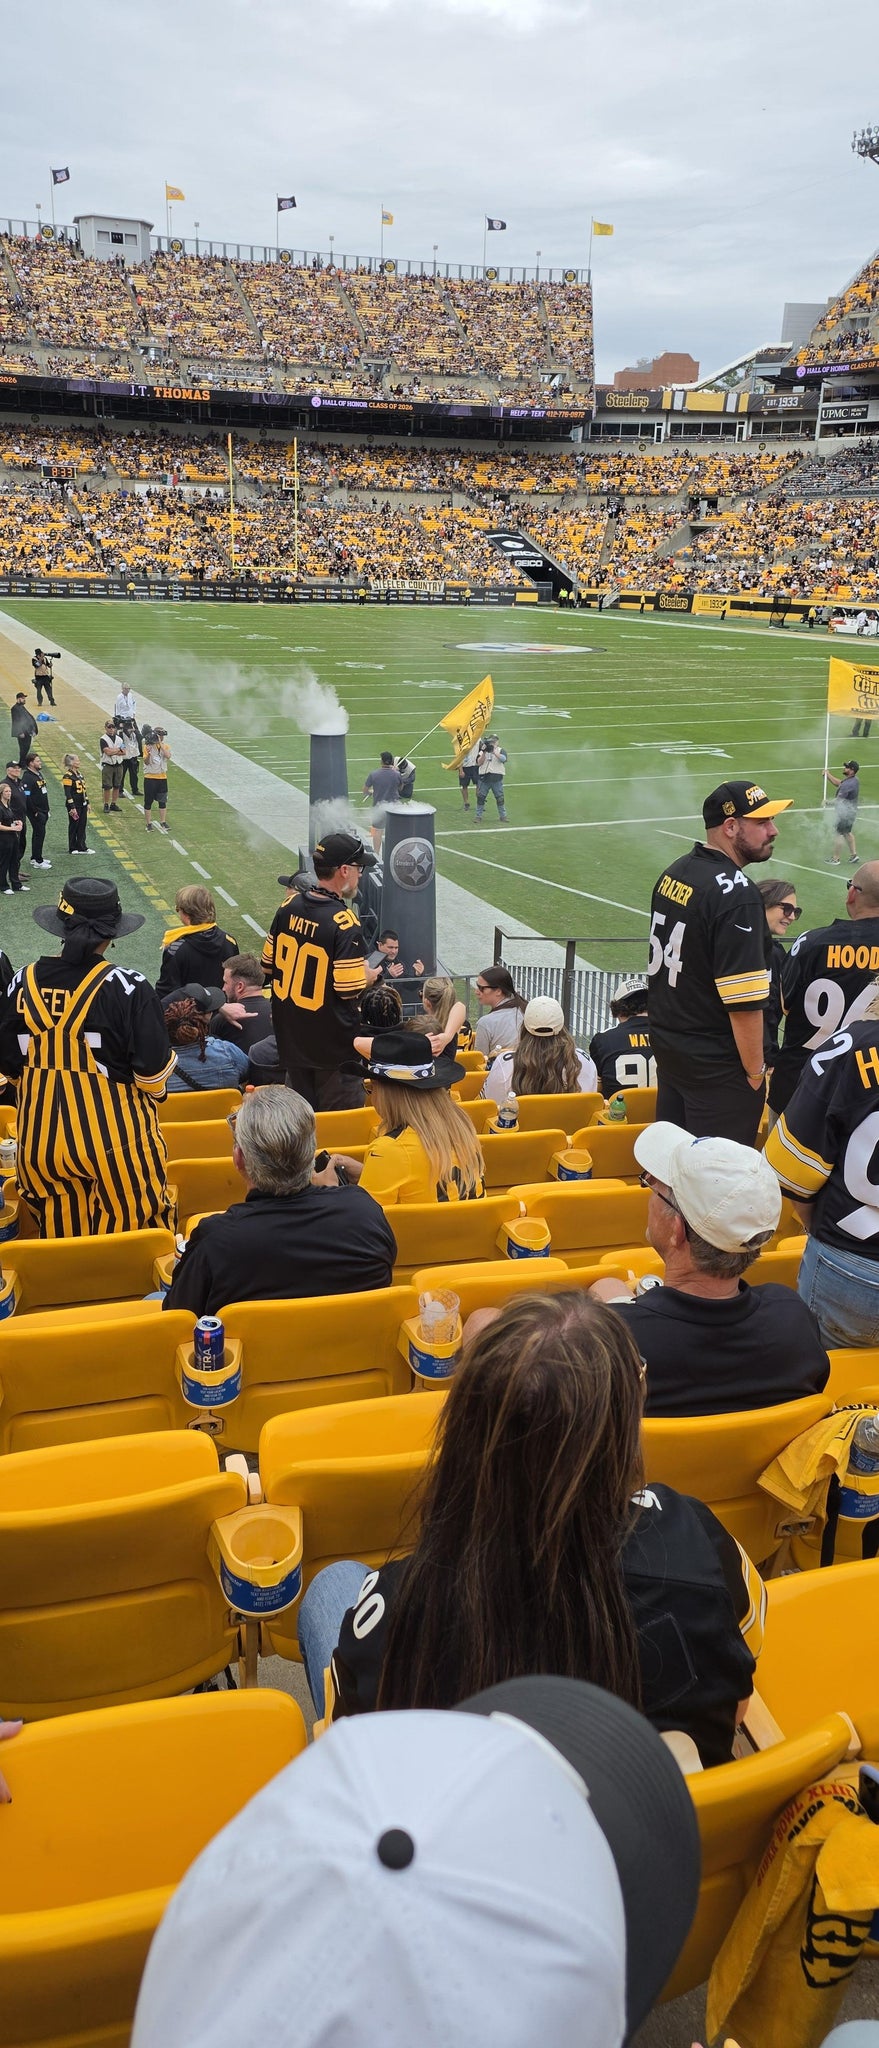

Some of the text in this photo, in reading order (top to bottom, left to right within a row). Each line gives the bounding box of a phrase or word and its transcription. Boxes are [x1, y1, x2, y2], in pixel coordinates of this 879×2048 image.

[830, 364, 850, 372] HONOR
[850, 361, 868, 370] CLASS
[868, 360, 877, 368] OF
[129, 385, 211, 400] J.T. THOMAS
[606, 392, 649, 408] Steelers
[778, 396, 799, 407] 1933
[510, 409, 528, 417] HELP?
[531, 410, 546, 418] TEXT
[822, 408, 849, 419] UPMC
[51, 467, 73, 478] 8:33
[514, 559, 544, 568] GEICO
[374, 580, 443, 593] STEELER COUNTRY
[659, 593, 689, 610] Steelers
[657, 874, 694, 907] FRAZIER
[715, 870, 749, 895] 54
[288, 914, 319, 938] WATT
[648, 911, 687, 988] 54
[826, 944, 879, 970] HOOD
[273, 932, 329, 1012] 90
[776, 1801, 804, 1843] BOWL
